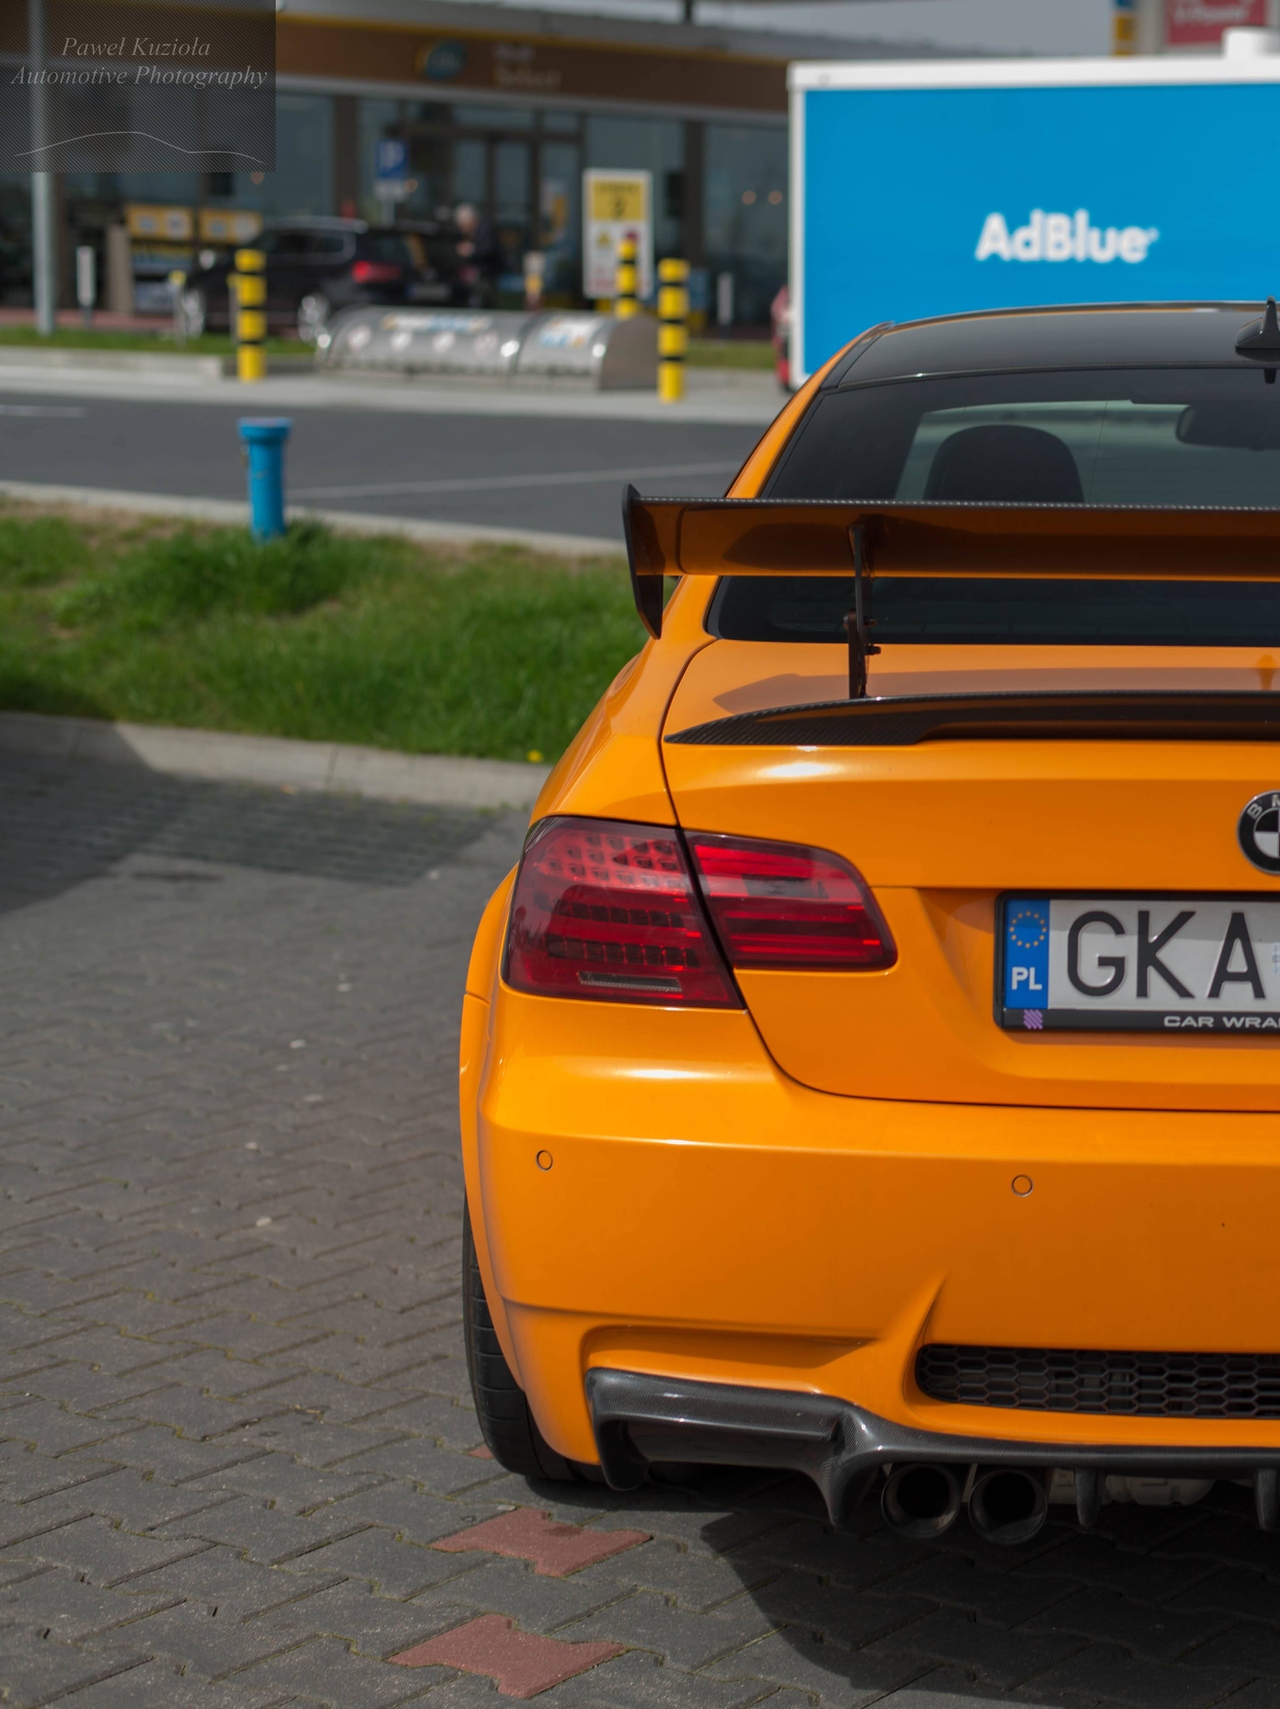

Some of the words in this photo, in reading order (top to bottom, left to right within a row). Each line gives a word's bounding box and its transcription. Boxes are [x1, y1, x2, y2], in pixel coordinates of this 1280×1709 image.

[975, 208, 1149, 264] AdBlue
[1066, 910, 1267, 999] GKA
[1011, 967, 1043, 991] PL
[1163, 1015, 1215, 1028] CAR
